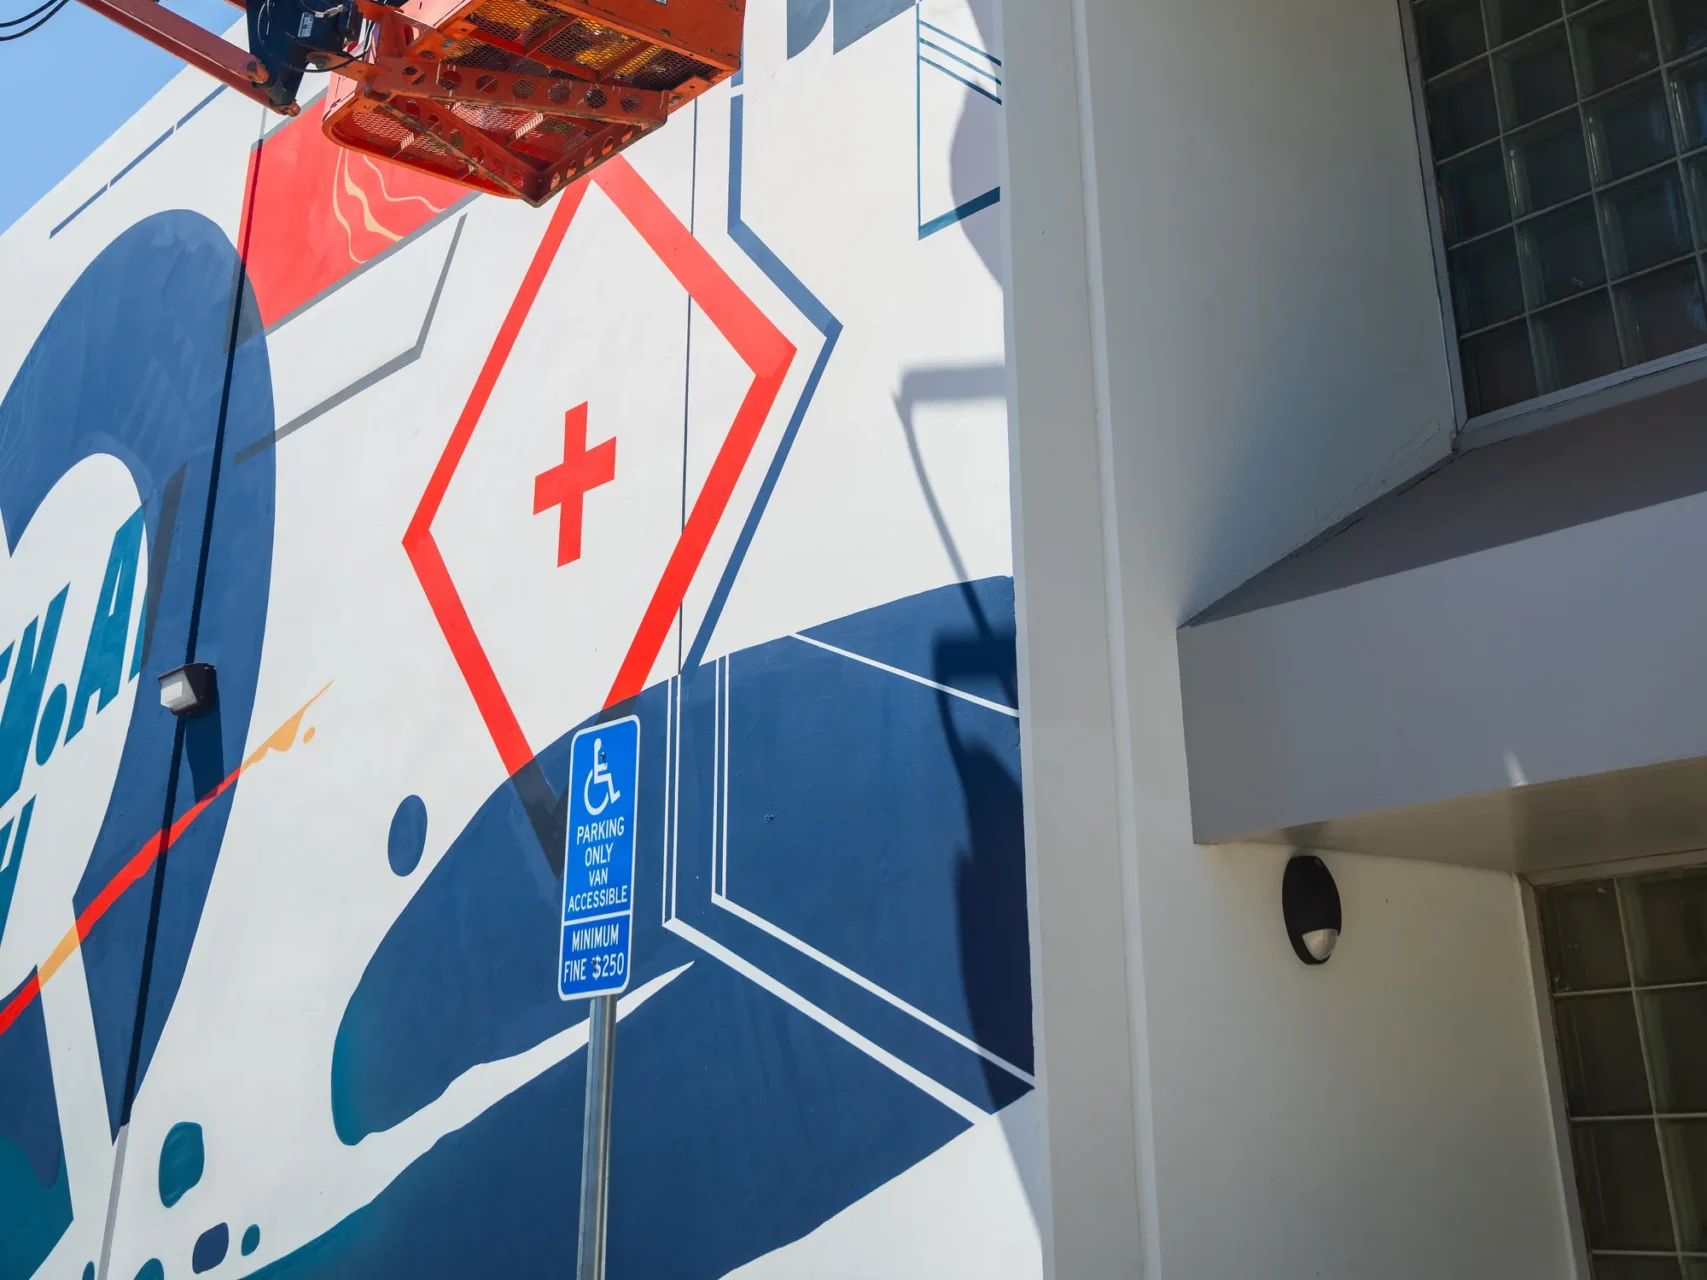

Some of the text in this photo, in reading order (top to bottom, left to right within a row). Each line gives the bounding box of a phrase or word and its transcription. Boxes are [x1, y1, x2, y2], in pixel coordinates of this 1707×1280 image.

[576, 816, 625, 845] PARKING
[584, 842, 614, 867] ONLY
[588, 867, 608, 887] VAN
[567, 884, 628, 913] ACCESSIBLE
[571, 923, 619, 952] MINIMUM
[563, 952, 624, 983] FINE $250
